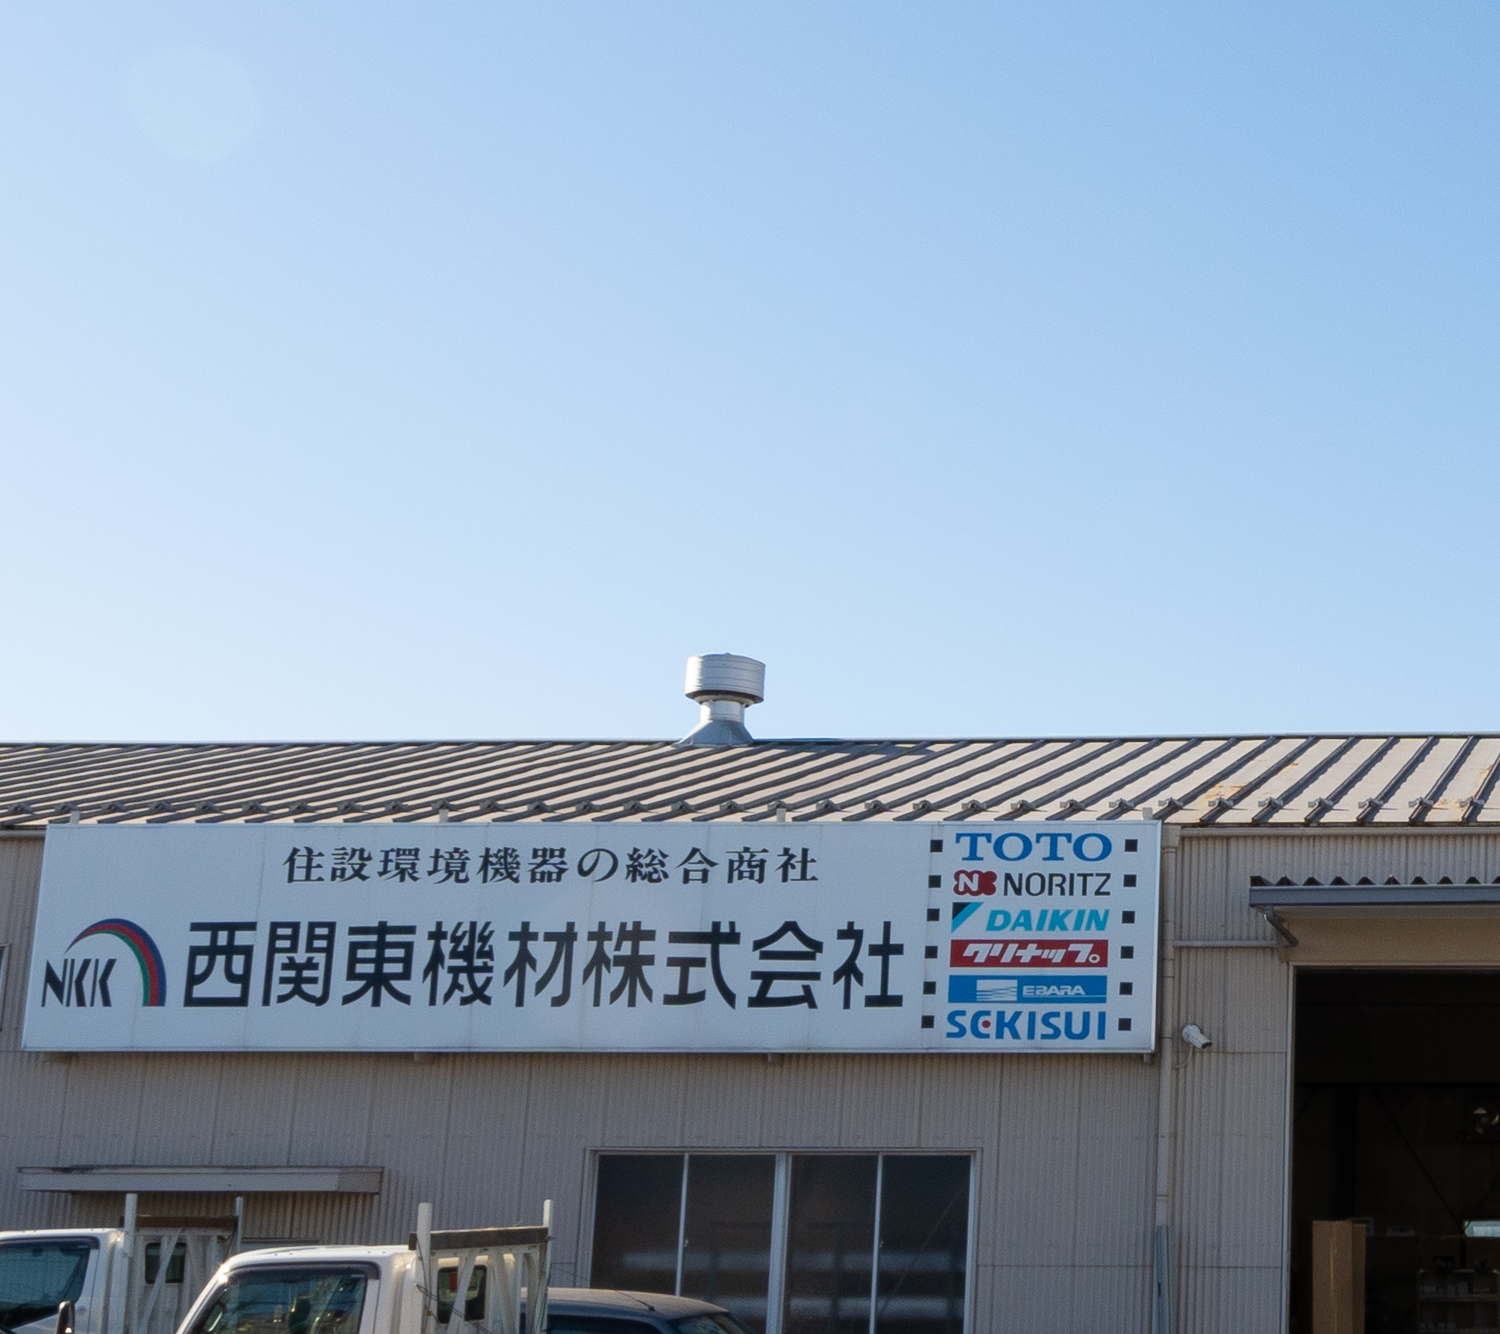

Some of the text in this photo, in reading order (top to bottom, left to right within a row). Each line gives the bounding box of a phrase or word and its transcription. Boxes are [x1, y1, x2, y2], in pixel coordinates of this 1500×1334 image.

[955, 832, 1112, 862] TOTO
[282, 846, 819, 885] 住設環境機器の総合商社
[1003, 872, 1111, 896] NORITZ
[985, 909, 1110, 932] DAIKIN
[183, 920, 904, 1010] 西関東機材株式会社
[962, 943, 1101, 964] クリナップ
[41, 958, 117, 1007] NKK
[1022, 985, 1086, 996] EBARA
[946, 1010, 1106, 1040] SEKISUI
